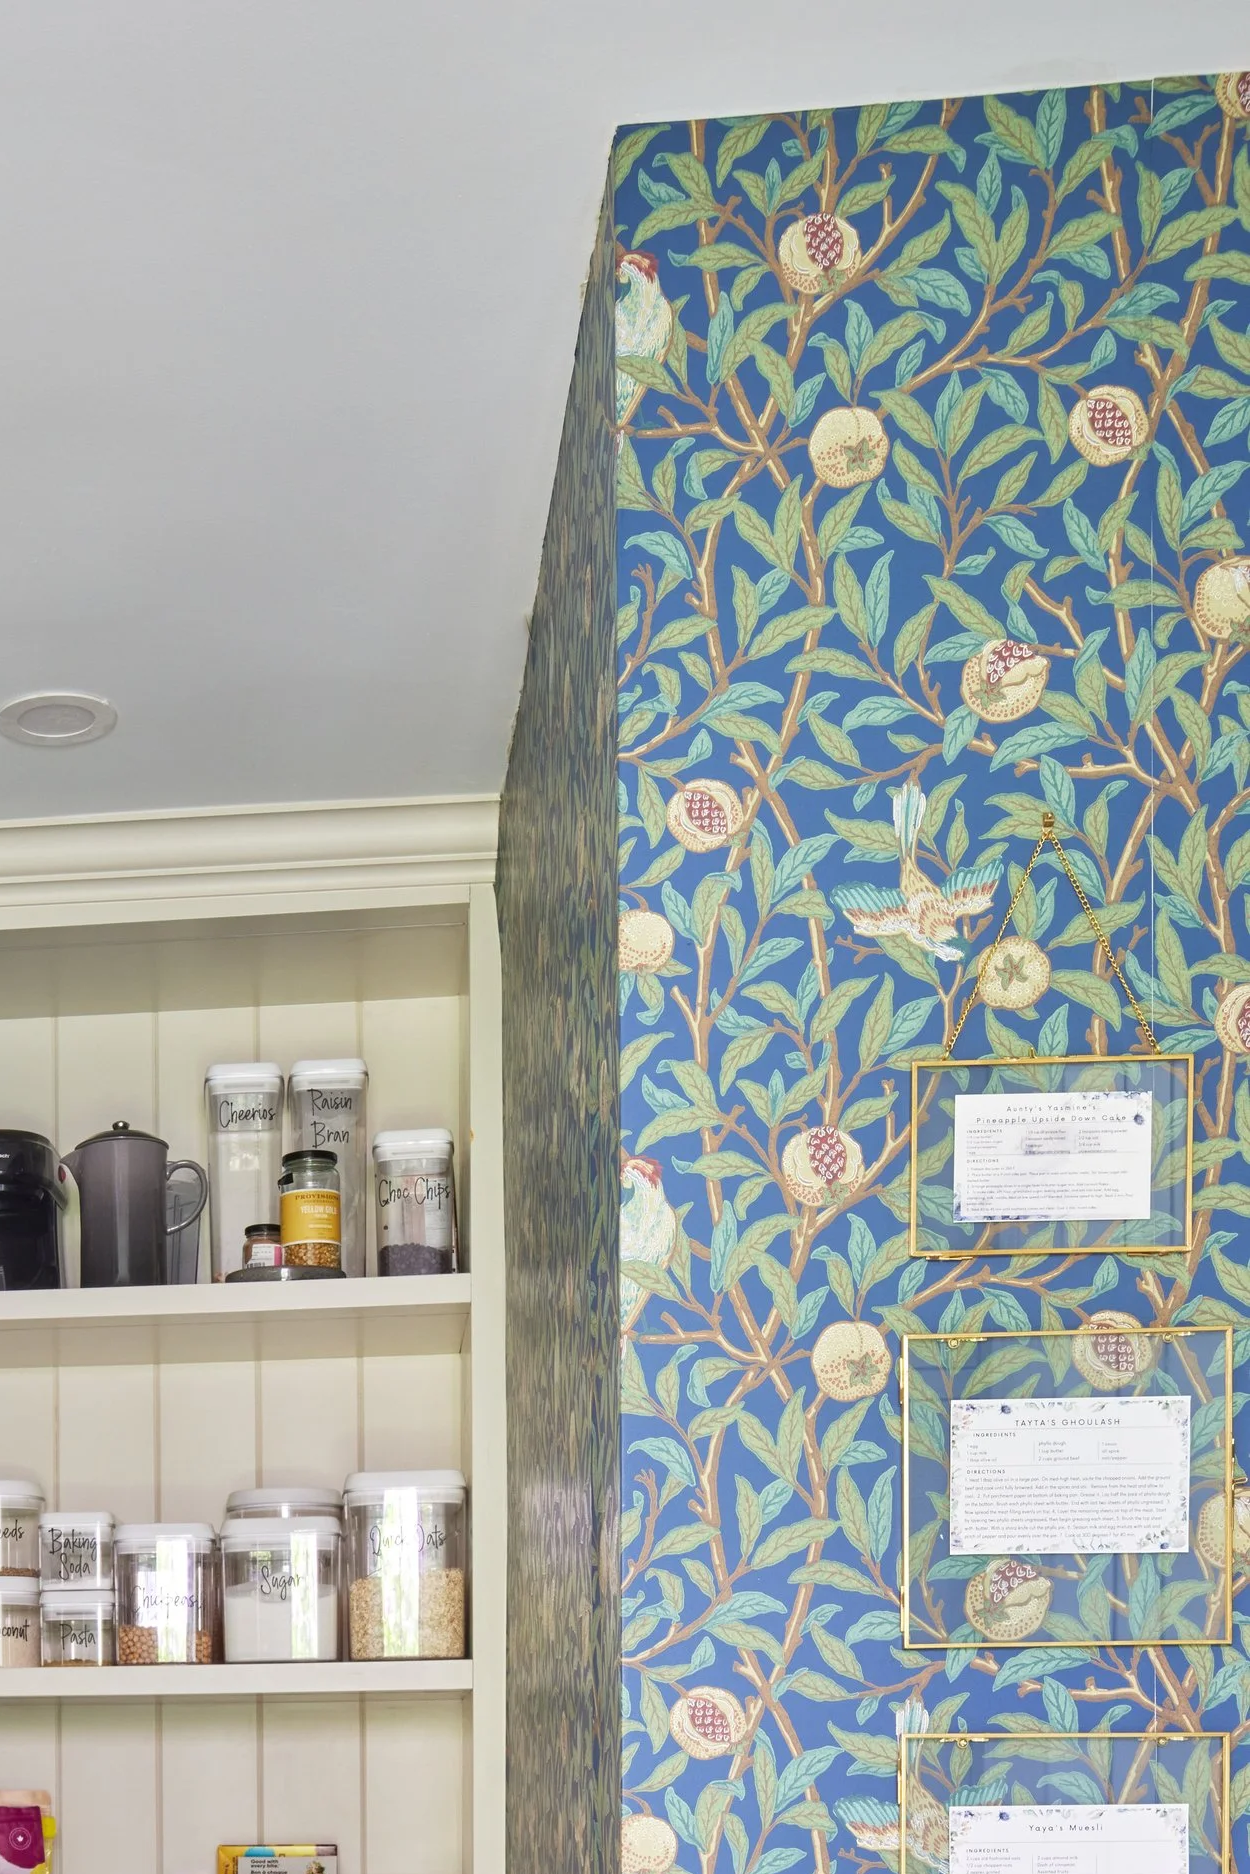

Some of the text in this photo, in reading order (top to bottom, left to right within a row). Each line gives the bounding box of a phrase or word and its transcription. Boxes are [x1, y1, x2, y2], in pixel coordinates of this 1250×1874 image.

[219, 1100, 276, 1129] Cheerios
[307, 1088, 352, 1116] Raisin
[1006, 1105, 1042, 1113] Aunty's
[976, 1113, 1127, 1124] Pineapple Upside Down Cake
[310, 1120, 350, 1148] Bran
[378, 1177, 451, 1209] Choc Chips
[1015, 1418, 1121, 1427] TAYTA'S GHOULASH
[48, 1528, 98, 1561] Baking
[59, 1553, 91, 1580] Soda
[260, 1565, 305, 1600] Sugar
[59, 1623, 96, 1649] Pasta
[1029, 1824, 1103, 1834] Yaya's Muesli
